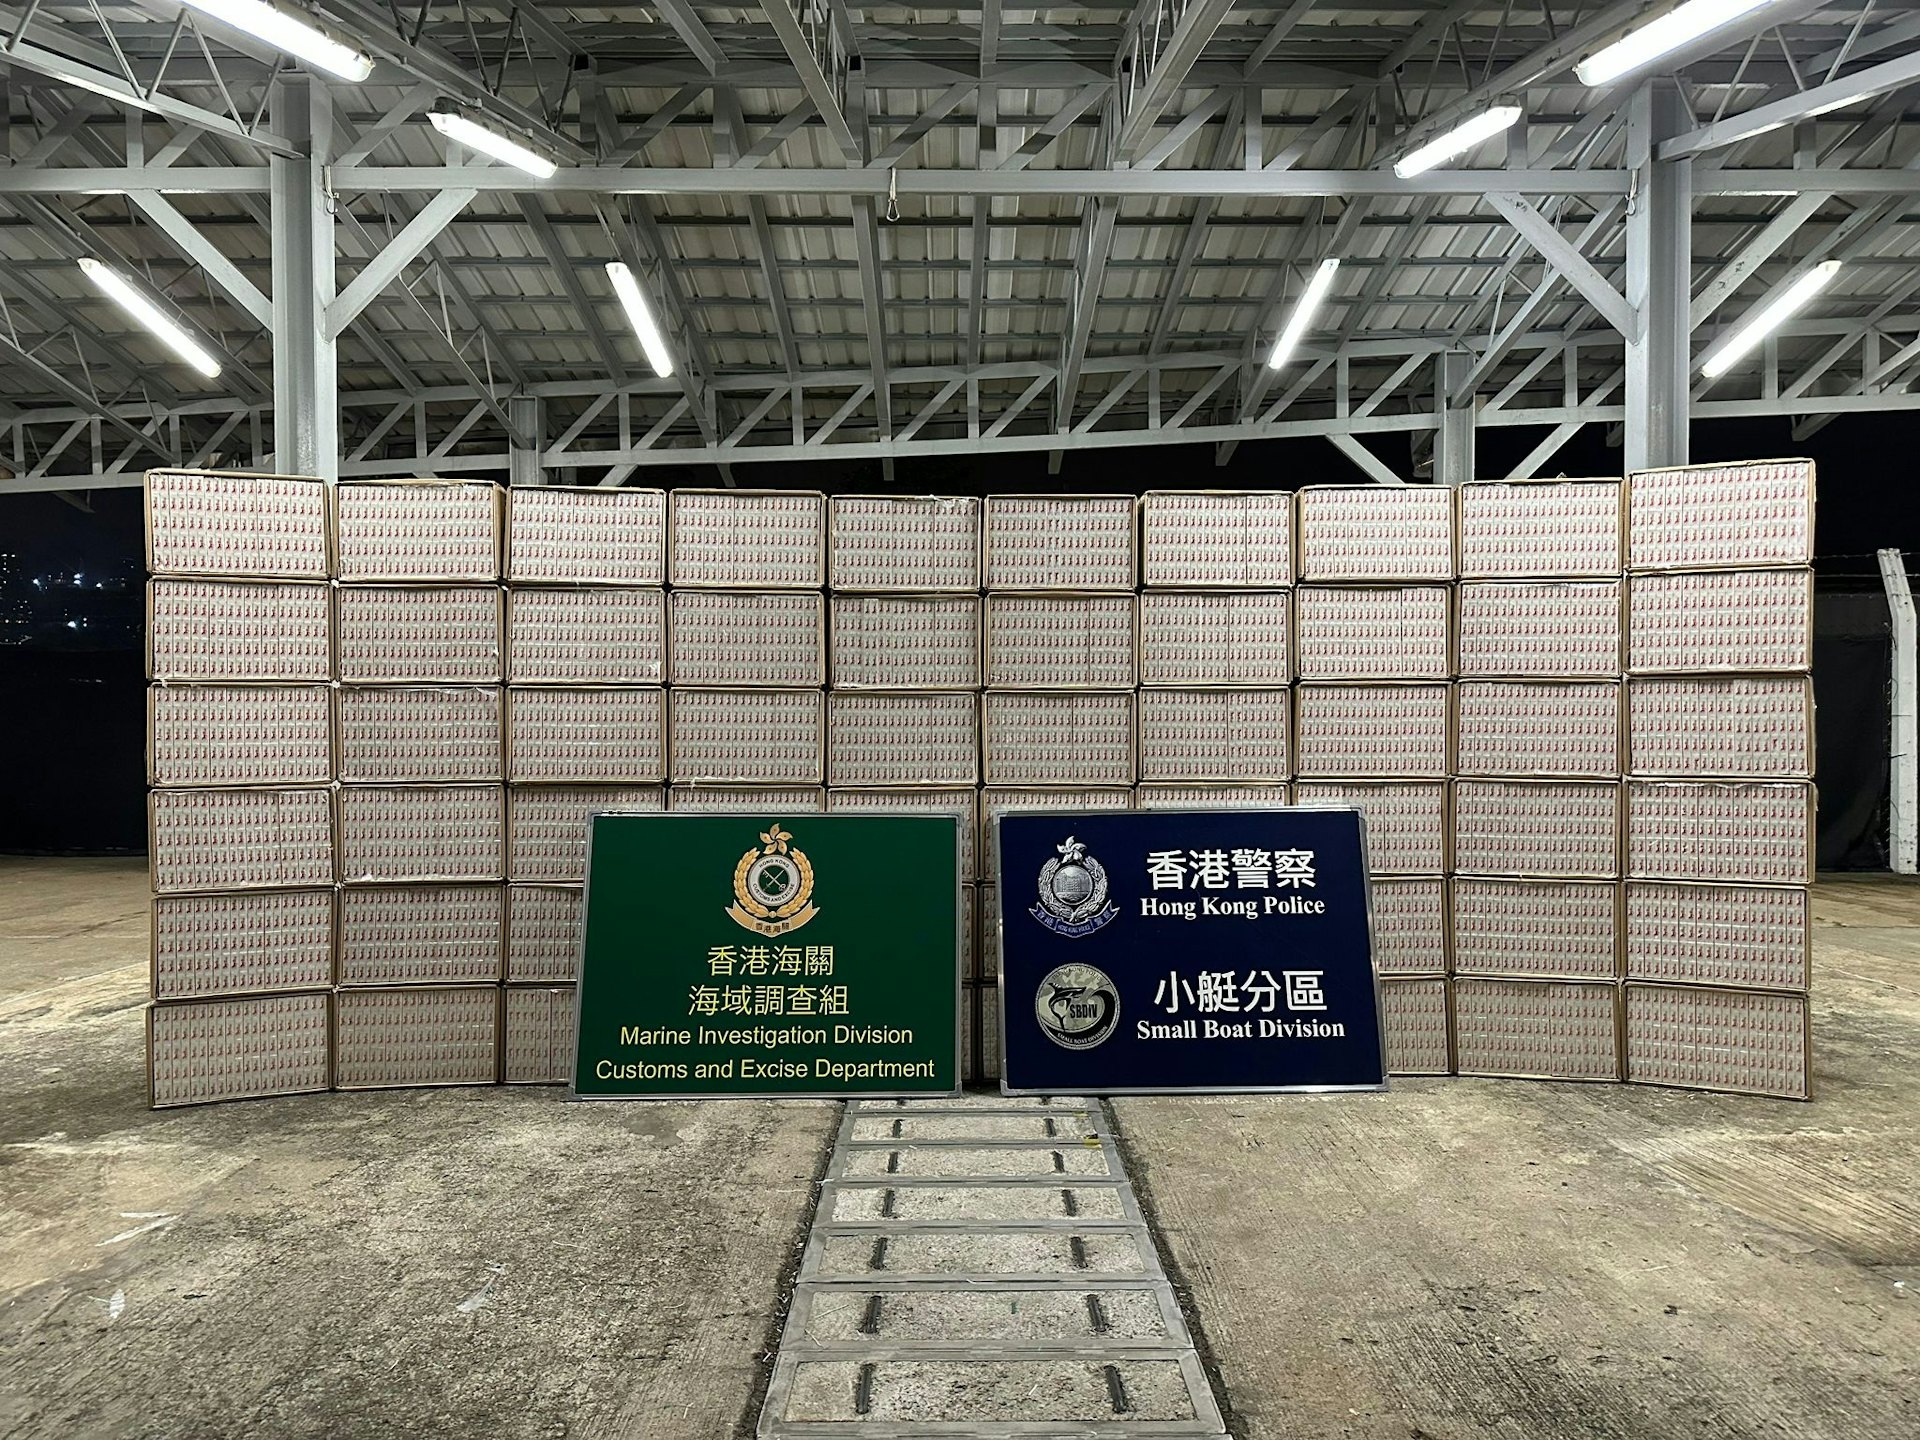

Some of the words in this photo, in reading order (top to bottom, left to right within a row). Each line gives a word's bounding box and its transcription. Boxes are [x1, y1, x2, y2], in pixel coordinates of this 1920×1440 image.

[1147, 848, 1316, 890] 香港警察
[1140, 898, 1196, 920] Hong
[1202, 897, 1258, 919] Kong
[1264, 896, 1325, 914] Police
[708, 945, 834, 976] 香港海關
[689, 985, 849, 1016] 海域調查組
[1154, 970, 1327, 1013] 小艇分區
[1070, 1003, 1098, 1018] SBDIV
[620, 1026, 691, 1045] Marine
[699, 1026, 826, 1048] Investigation
[835, 1025, 912, 1044] Division
[1137, 1020, 1197, 1039] Small
[1203, 1020, 1253, 1038] Boat
[1258, 1019, 1345, 1037] Division
[597, 1060, 688, 1079] Customs
[695, 1060, 733, 1078] and
[741, 1059, 809, 1078] Excise
[816, 1059, 935, 1081] Department
